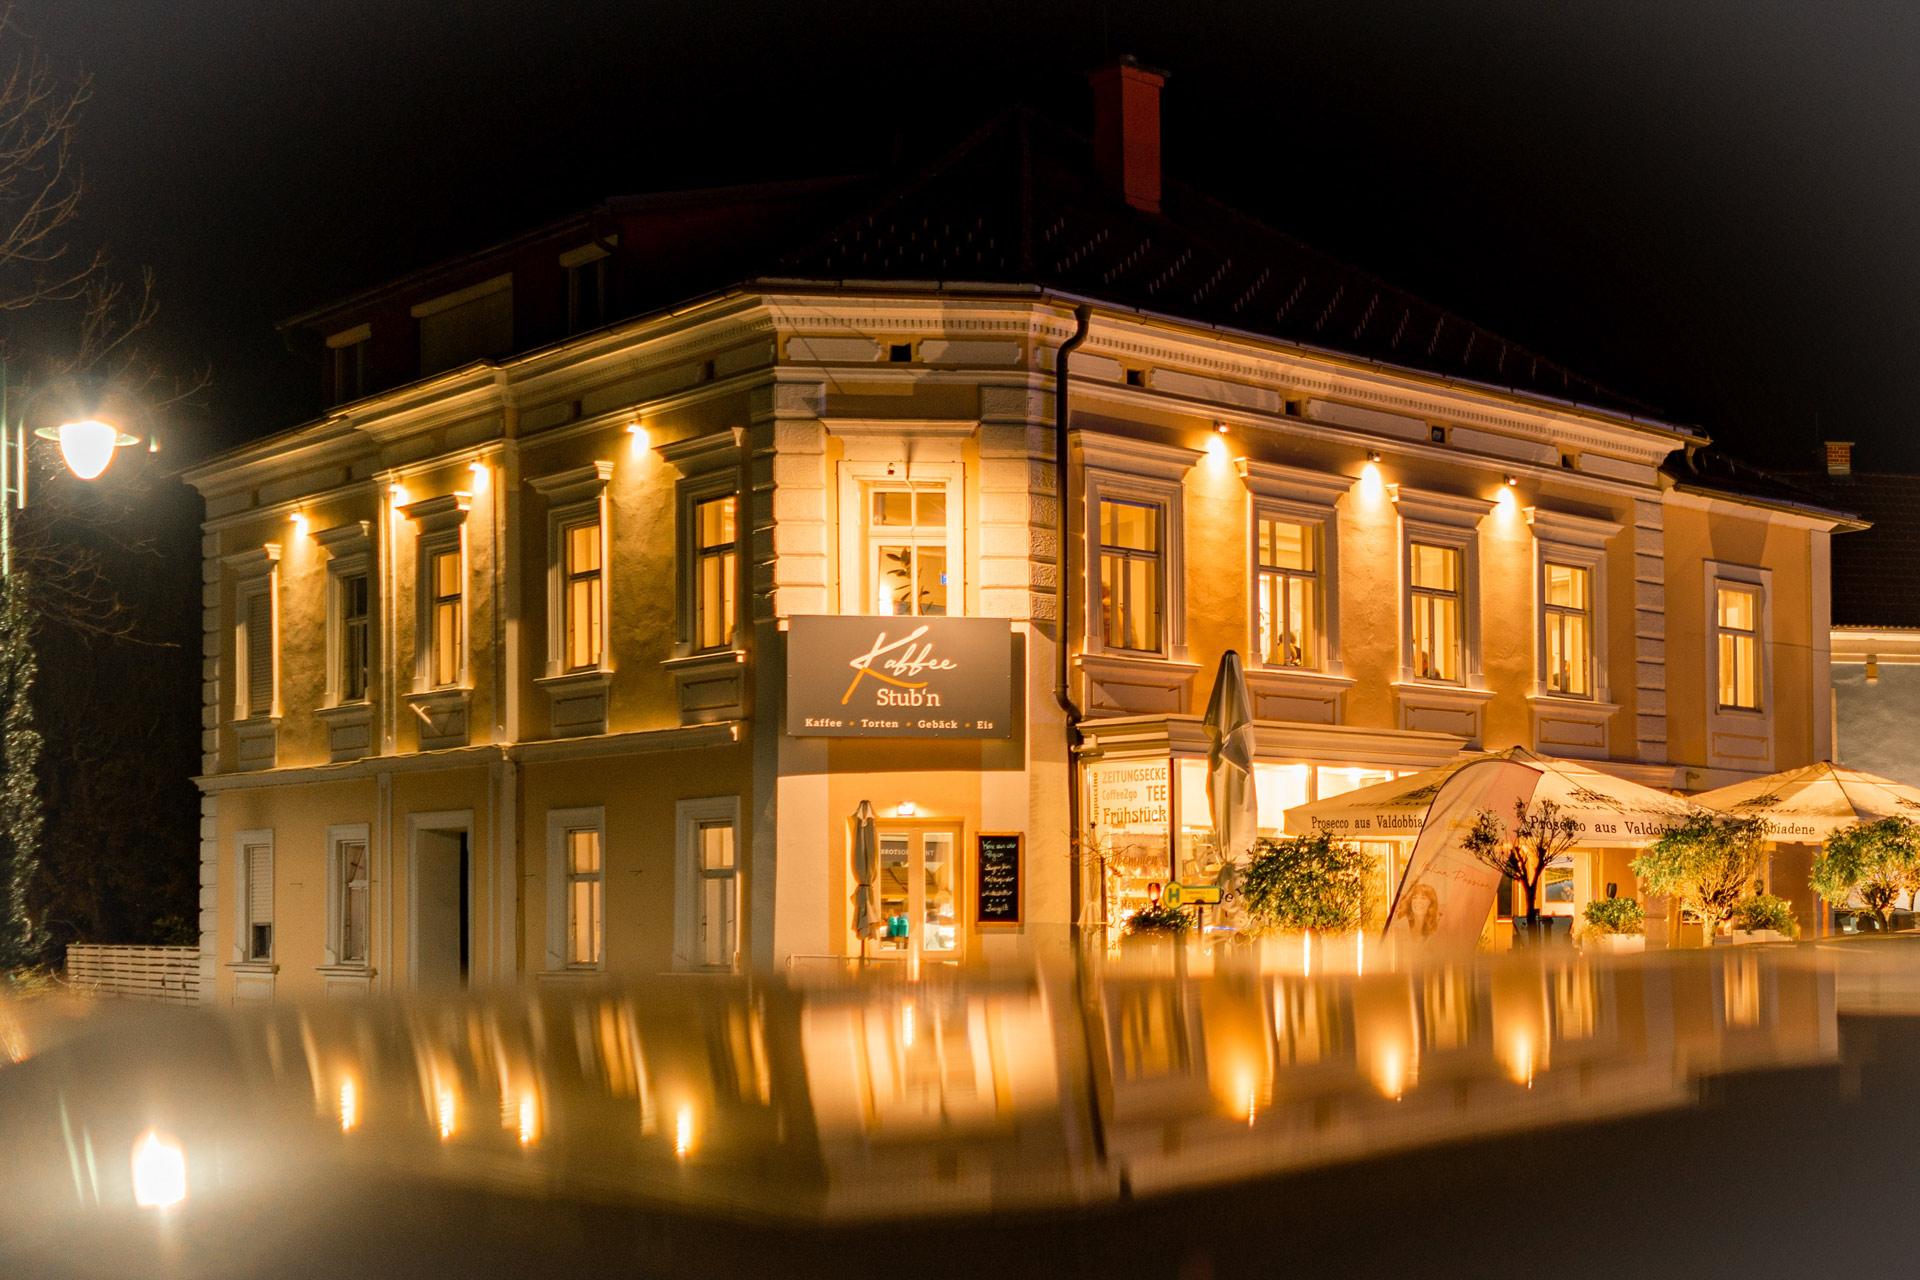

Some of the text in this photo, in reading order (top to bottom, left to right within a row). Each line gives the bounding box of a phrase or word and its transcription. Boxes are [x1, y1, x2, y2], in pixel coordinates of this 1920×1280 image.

[846, 625, 957, 682] Kaffee
[876, 688, 941, 707] Stub'n
[805, 718, 994, 730] Kaffee Torten Gebäck Eis
[1102, 768, 1166, 784] ZEITUNGSECKE
[1102, 788, 1138, 802] Coffee2go
[1146, 785, 1166, 802] TEE
[1103, 805, 1167, 825] Frühstück
[1311, 814, 1424, 829] Prosecco aus Valdobbia
[1594, 822, 1617, 833] aus
[1168, 888, 1180, 903] H
